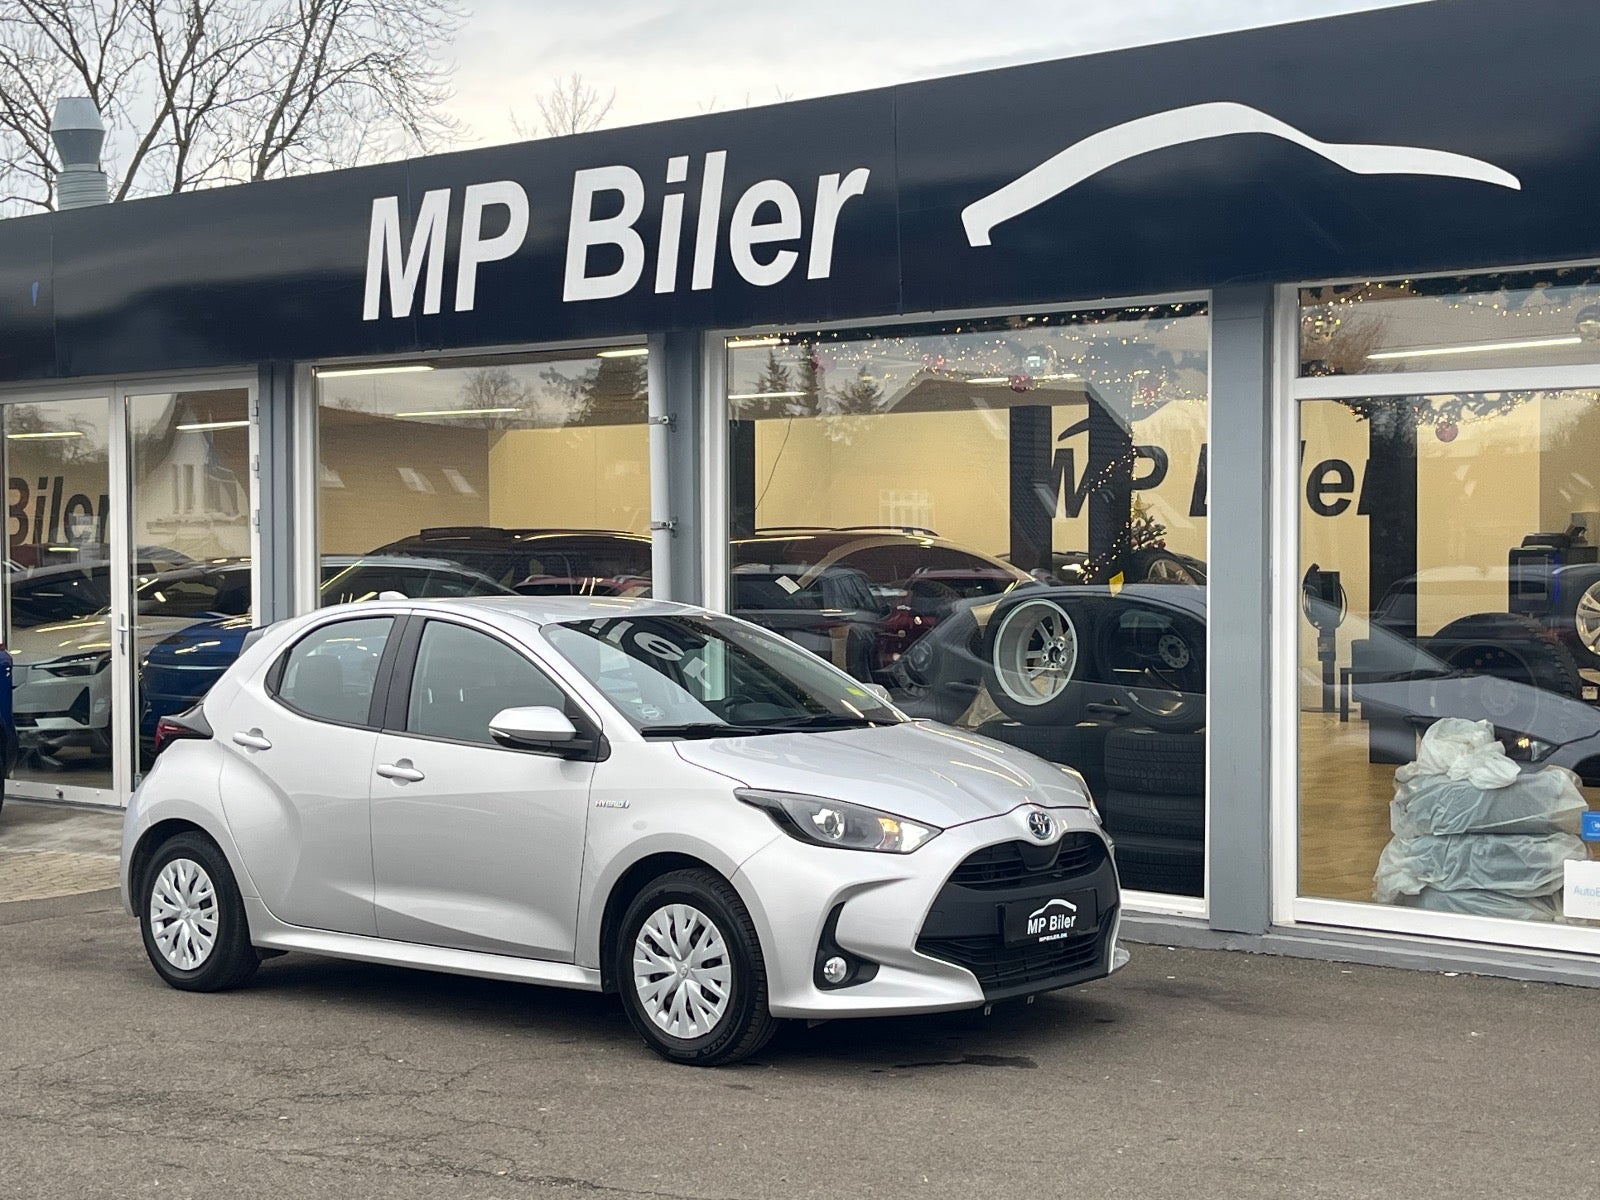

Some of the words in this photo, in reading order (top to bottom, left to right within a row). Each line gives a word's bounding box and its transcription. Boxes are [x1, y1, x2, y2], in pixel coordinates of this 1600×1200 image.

[363, 180, 530, 321] MP
[563, 150, 869, 302] Biler
[1027, 917, 1047, 935] MP
[1049, 914, 1077, 931] Biler
